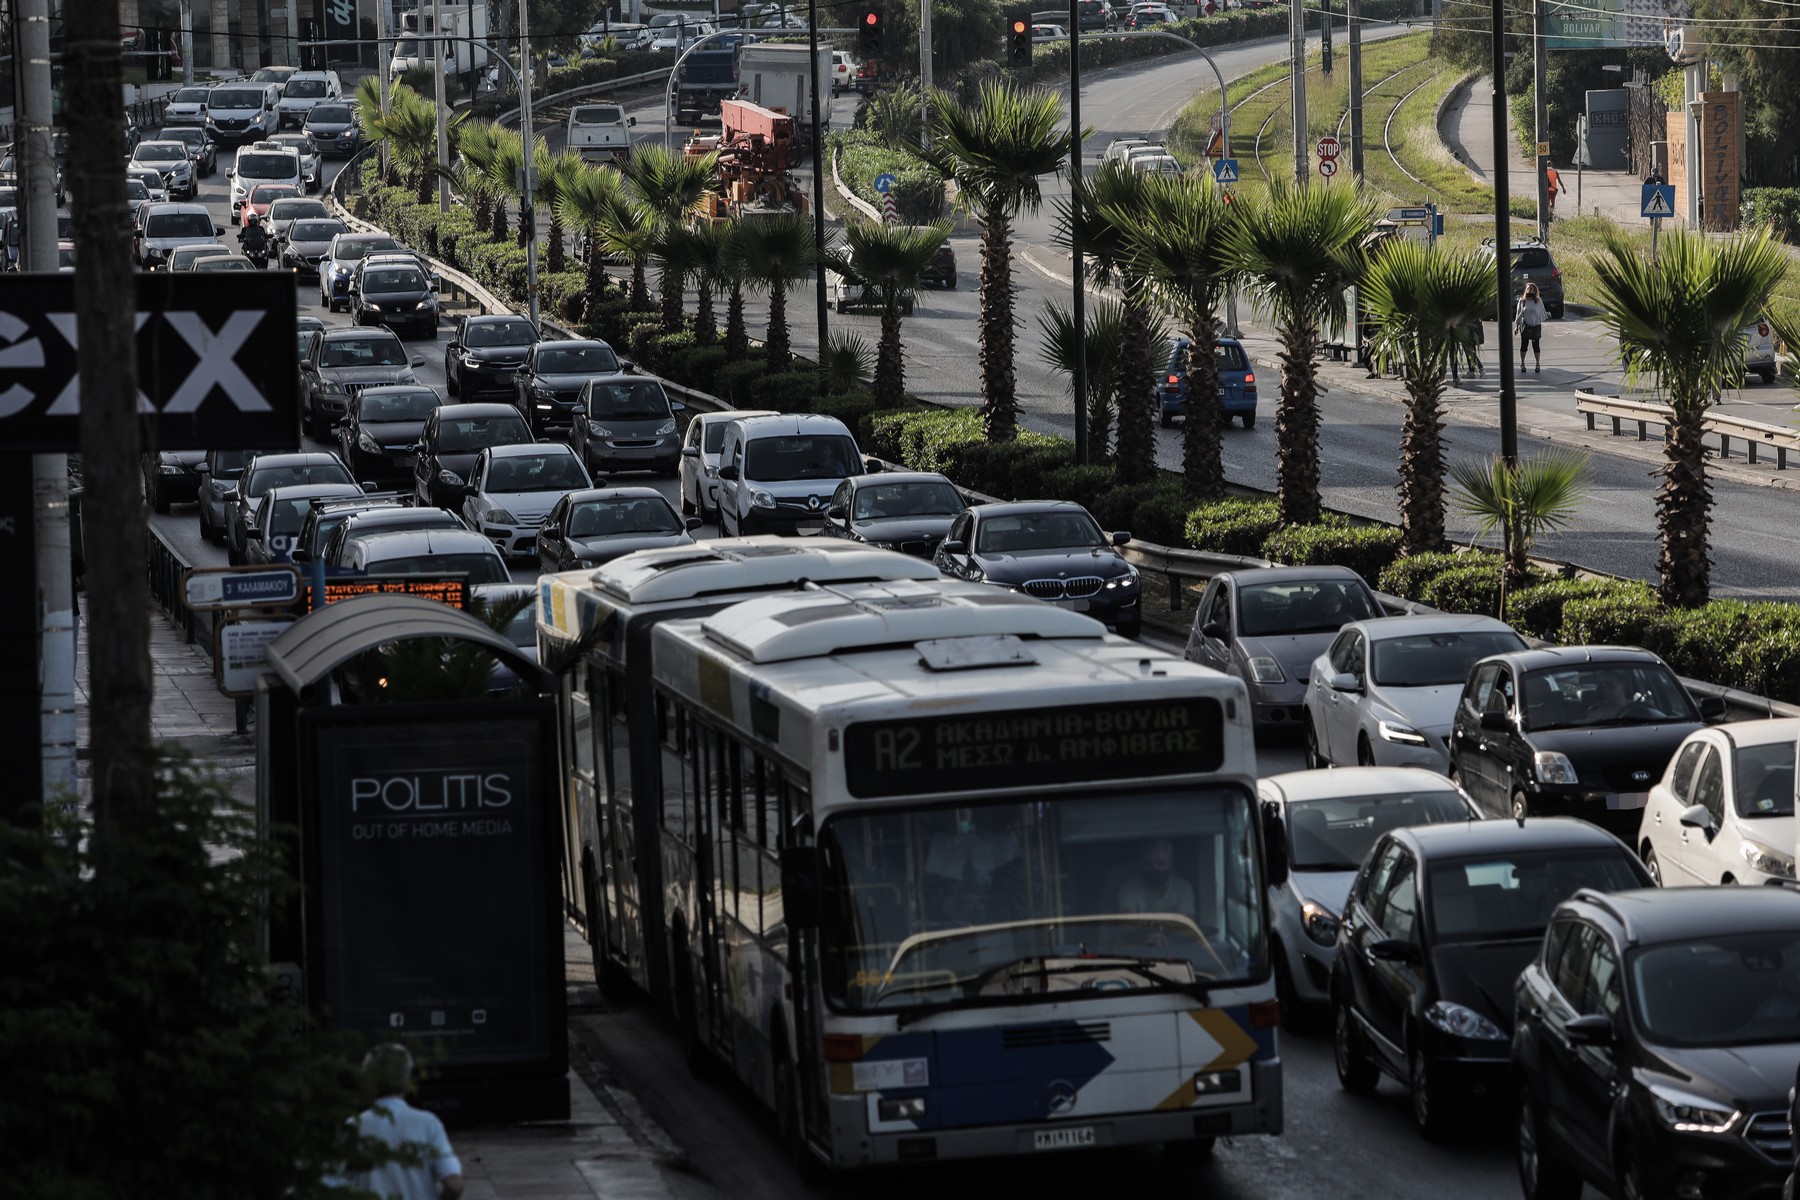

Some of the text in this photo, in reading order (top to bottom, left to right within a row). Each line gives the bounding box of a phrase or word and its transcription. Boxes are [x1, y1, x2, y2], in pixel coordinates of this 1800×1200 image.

[1563, 23, 1601, 34] BOLIVAR
[1211, 116, 1231, 128] STP
[1318, 143, 1339, 156] STOP
[1539, 145, 1547, 153] 50
[936, 745, 1014, 769] ΜΕΣΩ
[1059, 730, 1201, 760] ΑΜΦΙΘΕΑΣ
[351, 773, 512, 812] POLITIS
[352, 819, 513, 840] OUT OF HOME MEDIA
